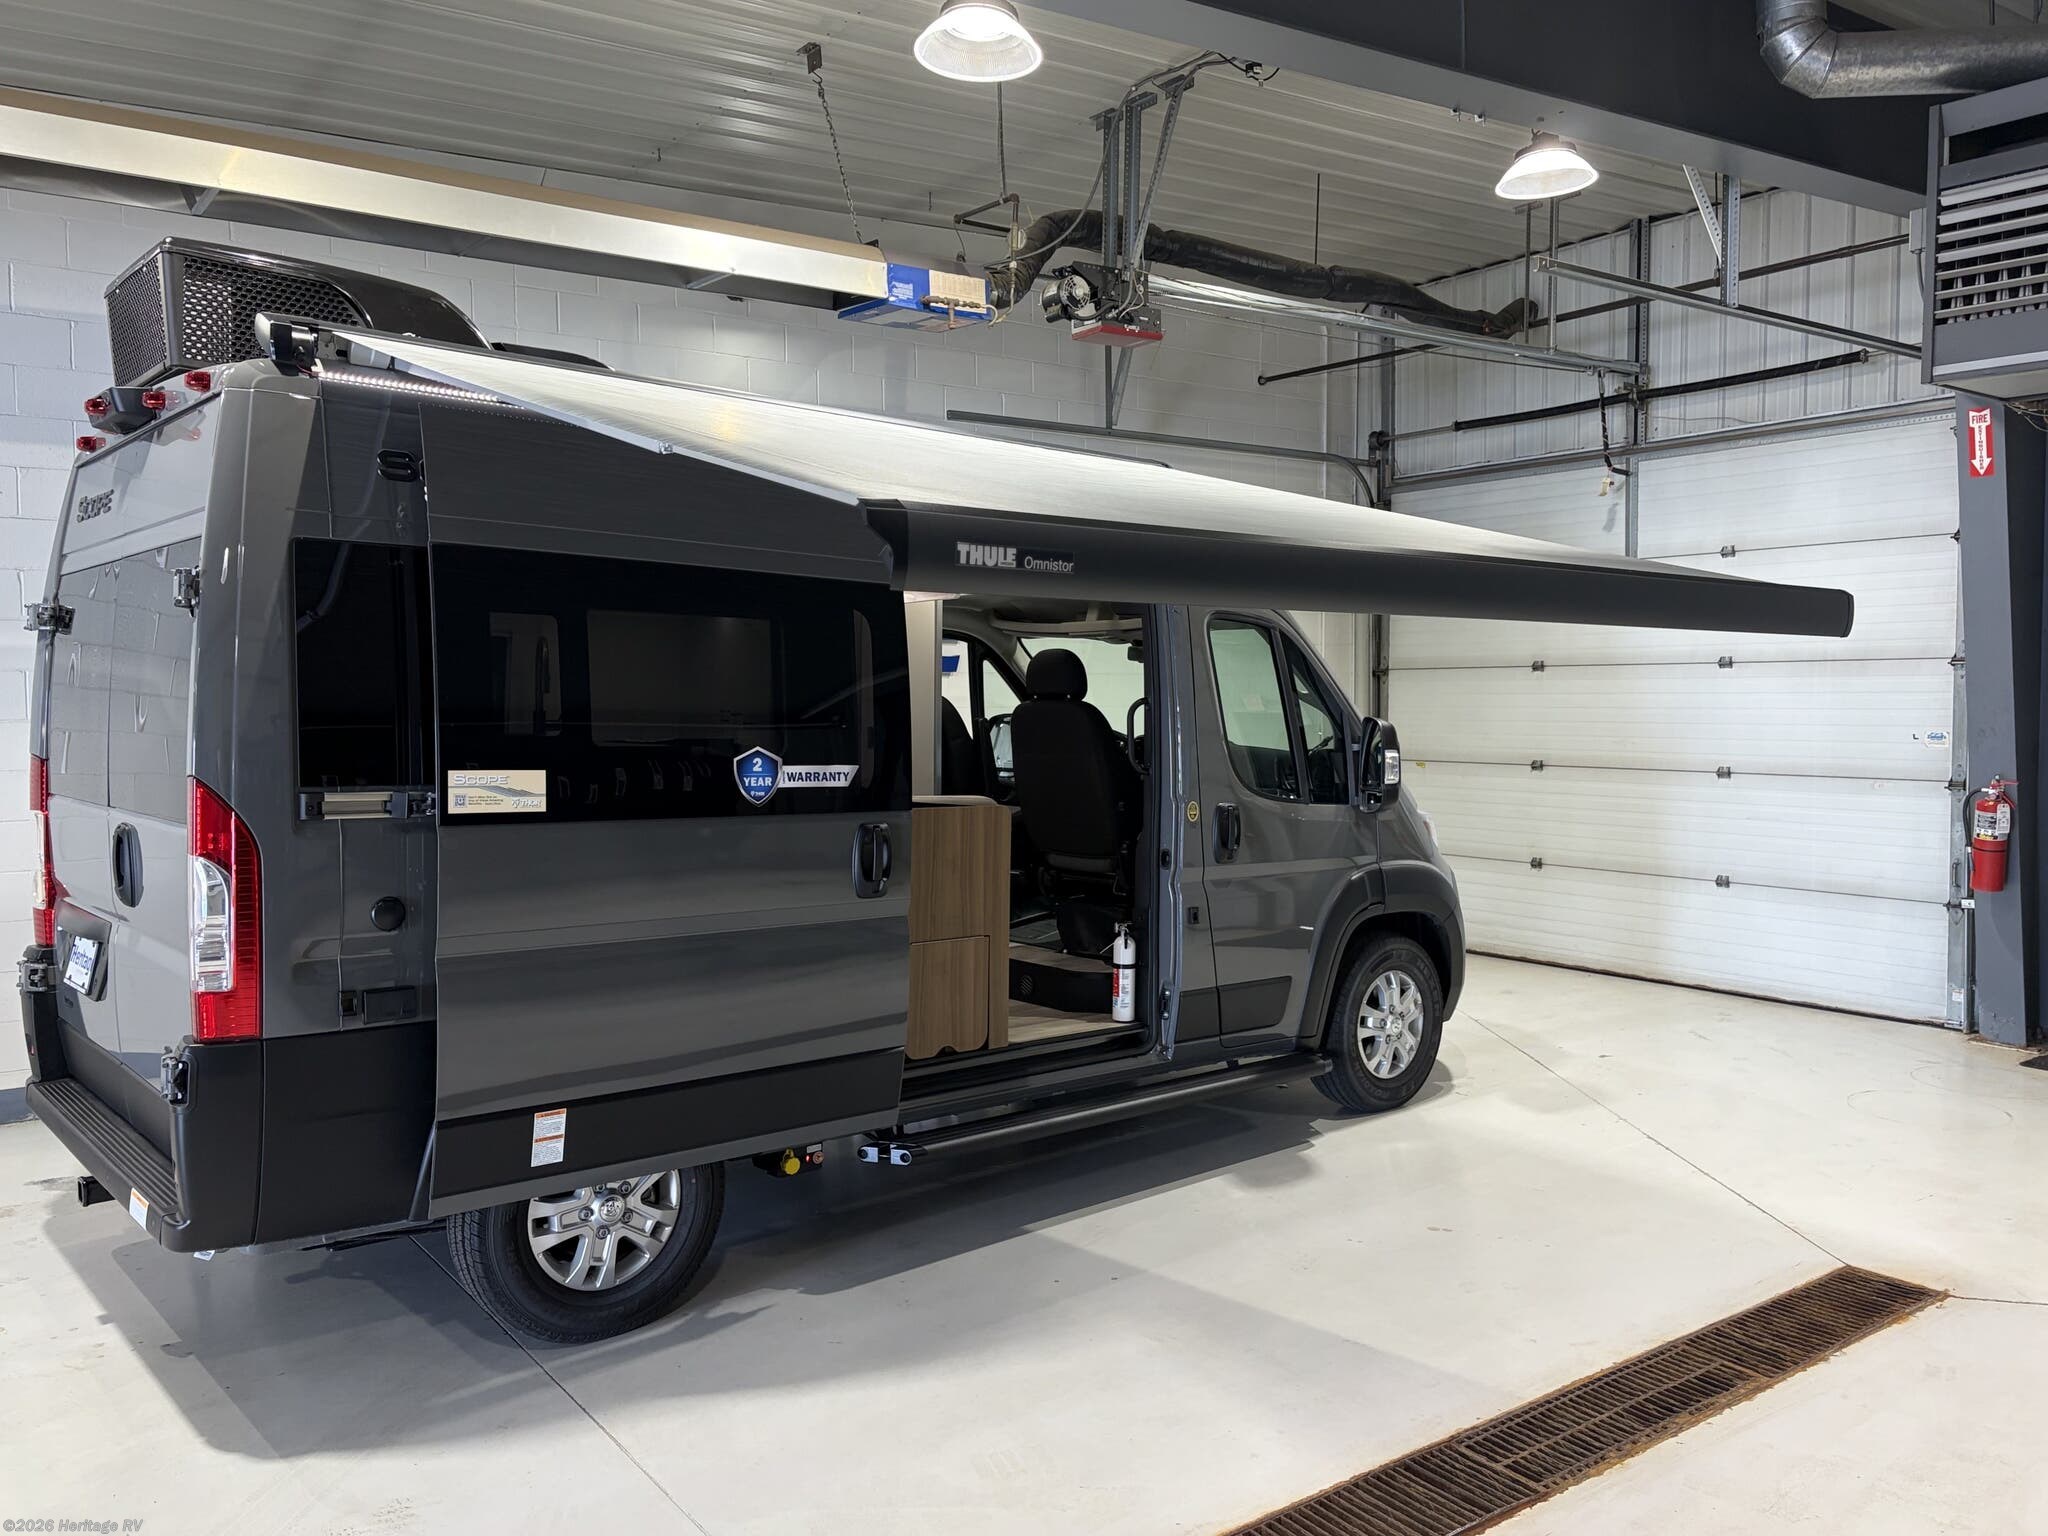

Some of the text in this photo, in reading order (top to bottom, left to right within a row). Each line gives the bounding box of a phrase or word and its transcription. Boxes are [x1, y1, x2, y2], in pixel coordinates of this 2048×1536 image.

[1972, 413, 1988, 425] FIRE
[957, 541, 1074, 572] THULE Omnistor
[752, 757, 763, 772] 2
[743, 777, 772, 786] YEAR
[786, 772, 849, 782] WARRANTY
